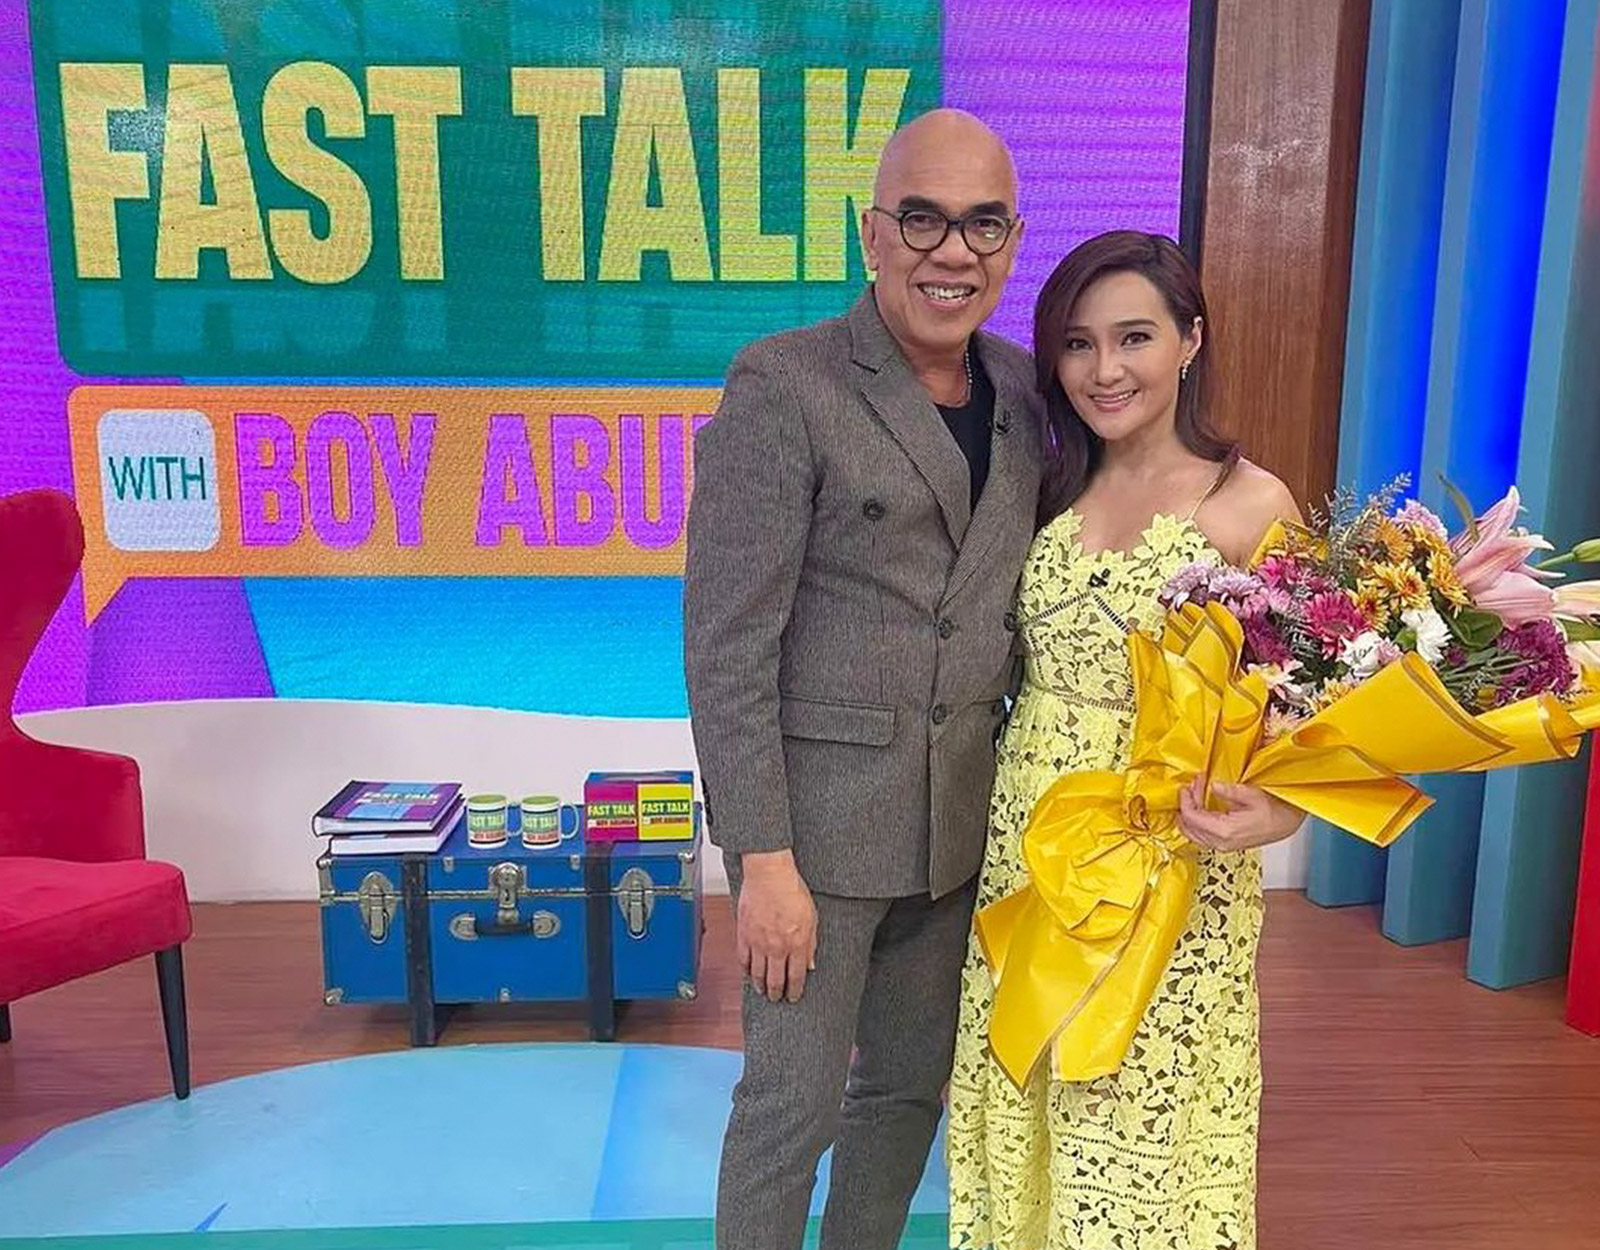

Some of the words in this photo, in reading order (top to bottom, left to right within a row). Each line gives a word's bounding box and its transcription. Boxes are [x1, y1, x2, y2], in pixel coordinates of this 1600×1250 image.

[59, 61, 462, 284] FAST
[511, 67, 910, 281] TALK
[108, 456, 206, 501] WITH
[234, 410, 437, 550] BOY
[474, 412, 714, 550] ABU
[587, 804, 608, 816] FAST
[612, 804, 635, 815] TALK
[642, 802, 665, 814] FAST
[667, 801, 689, 813] TALK
